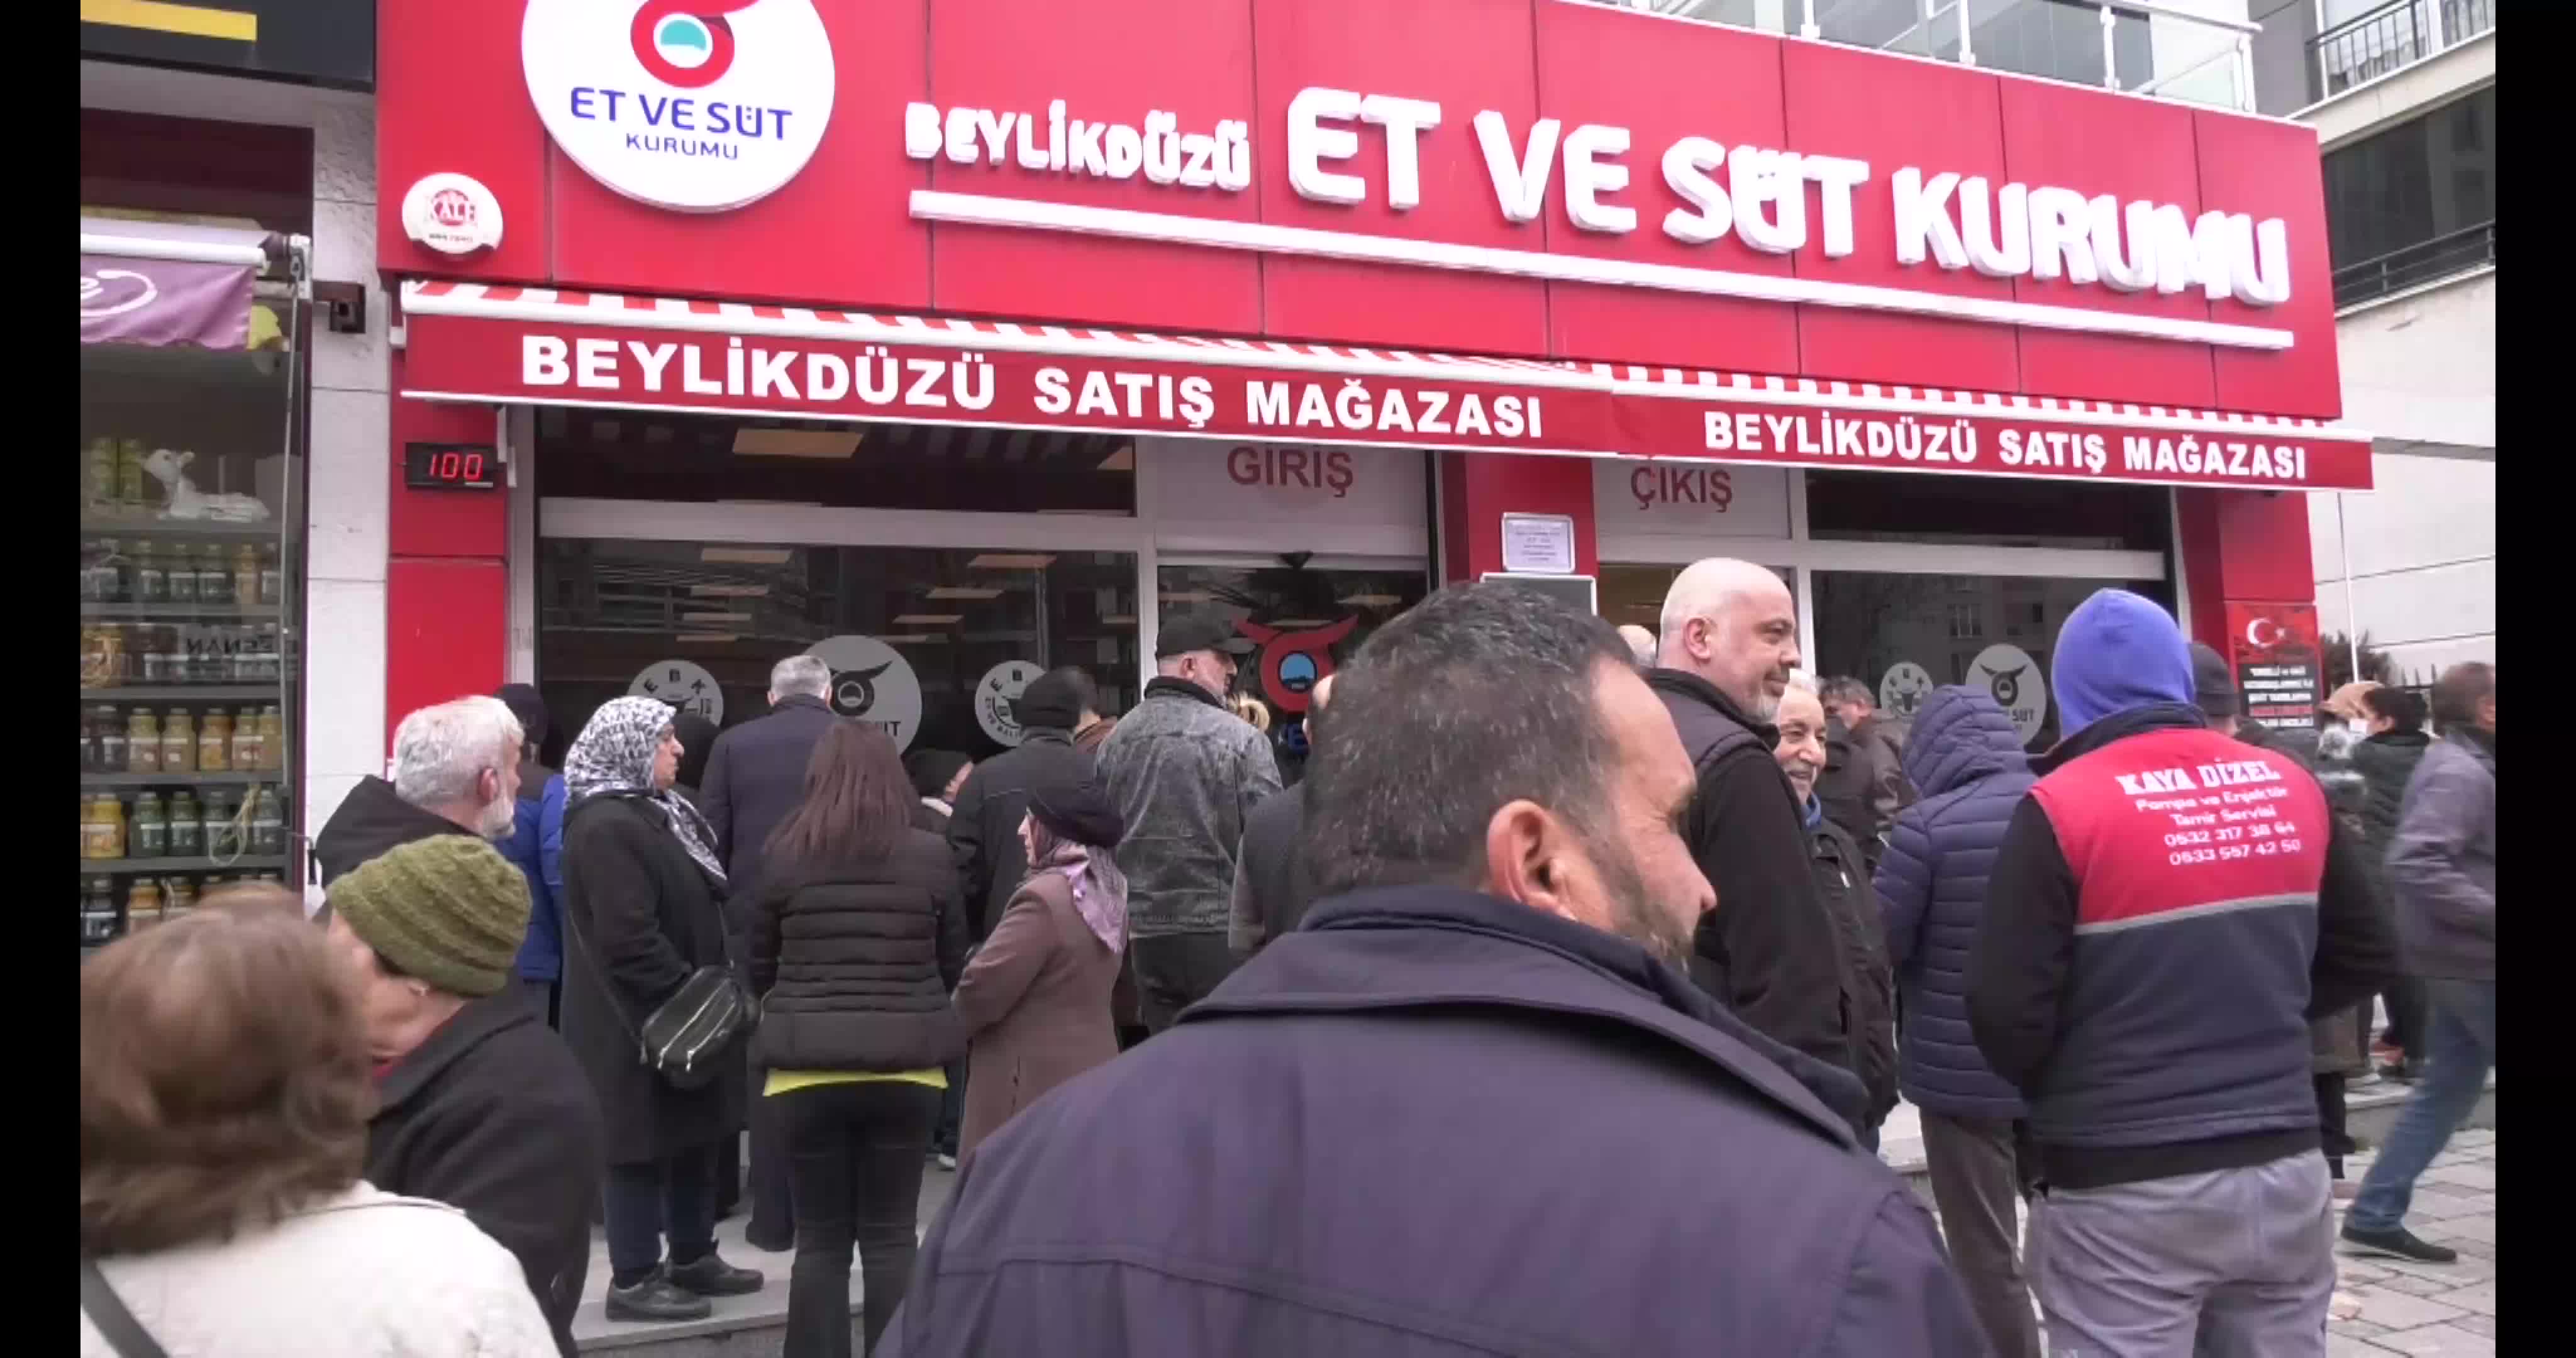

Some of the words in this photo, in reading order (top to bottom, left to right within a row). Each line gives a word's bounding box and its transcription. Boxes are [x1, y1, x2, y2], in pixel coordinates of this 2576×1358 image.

[570, 87, 626, 122] ET
[638, 94, 695, 131] VE
[706, 102, 793, 140] SÜT
[626, 133, 738, 160] KURUMU
[904, 99, 1251, 192] BEYLİKDÜZÜ
[1287, 86, 1441, 209] ET
[1472, 109, 1636, 233] VE
[1660, 135, 1870, 258] SÜT
[1892, 166, 2290, 305] KURUMU
[522, 334, 995, 410] BEYLİKDÜZÜ
[1033, 367, 1215, 428] SATIŞ
[1246, 377, 1542, 438] MAĞAZASI
[1704, 410, 1977, 463] BEYLİKDÜZÜ
[1999, 429, 2107, 474] SATIŞ
[2123, 433, 2306, 480] MAĞAZASI
[429, 453, 483, 482] 100
[1631, 467, 1732, 513] ÇIKIŞ
[2114, 768, 2197, 795] KAYA
[2196, 757, 2282, 787] DİZEL
[2135, 798, 2197, 812] Pompa
[2199, 796, 2221, 805] ve
[2170, 813, 2216, 826] Tamir
[2220, 805, 2277, 822] Servisi
